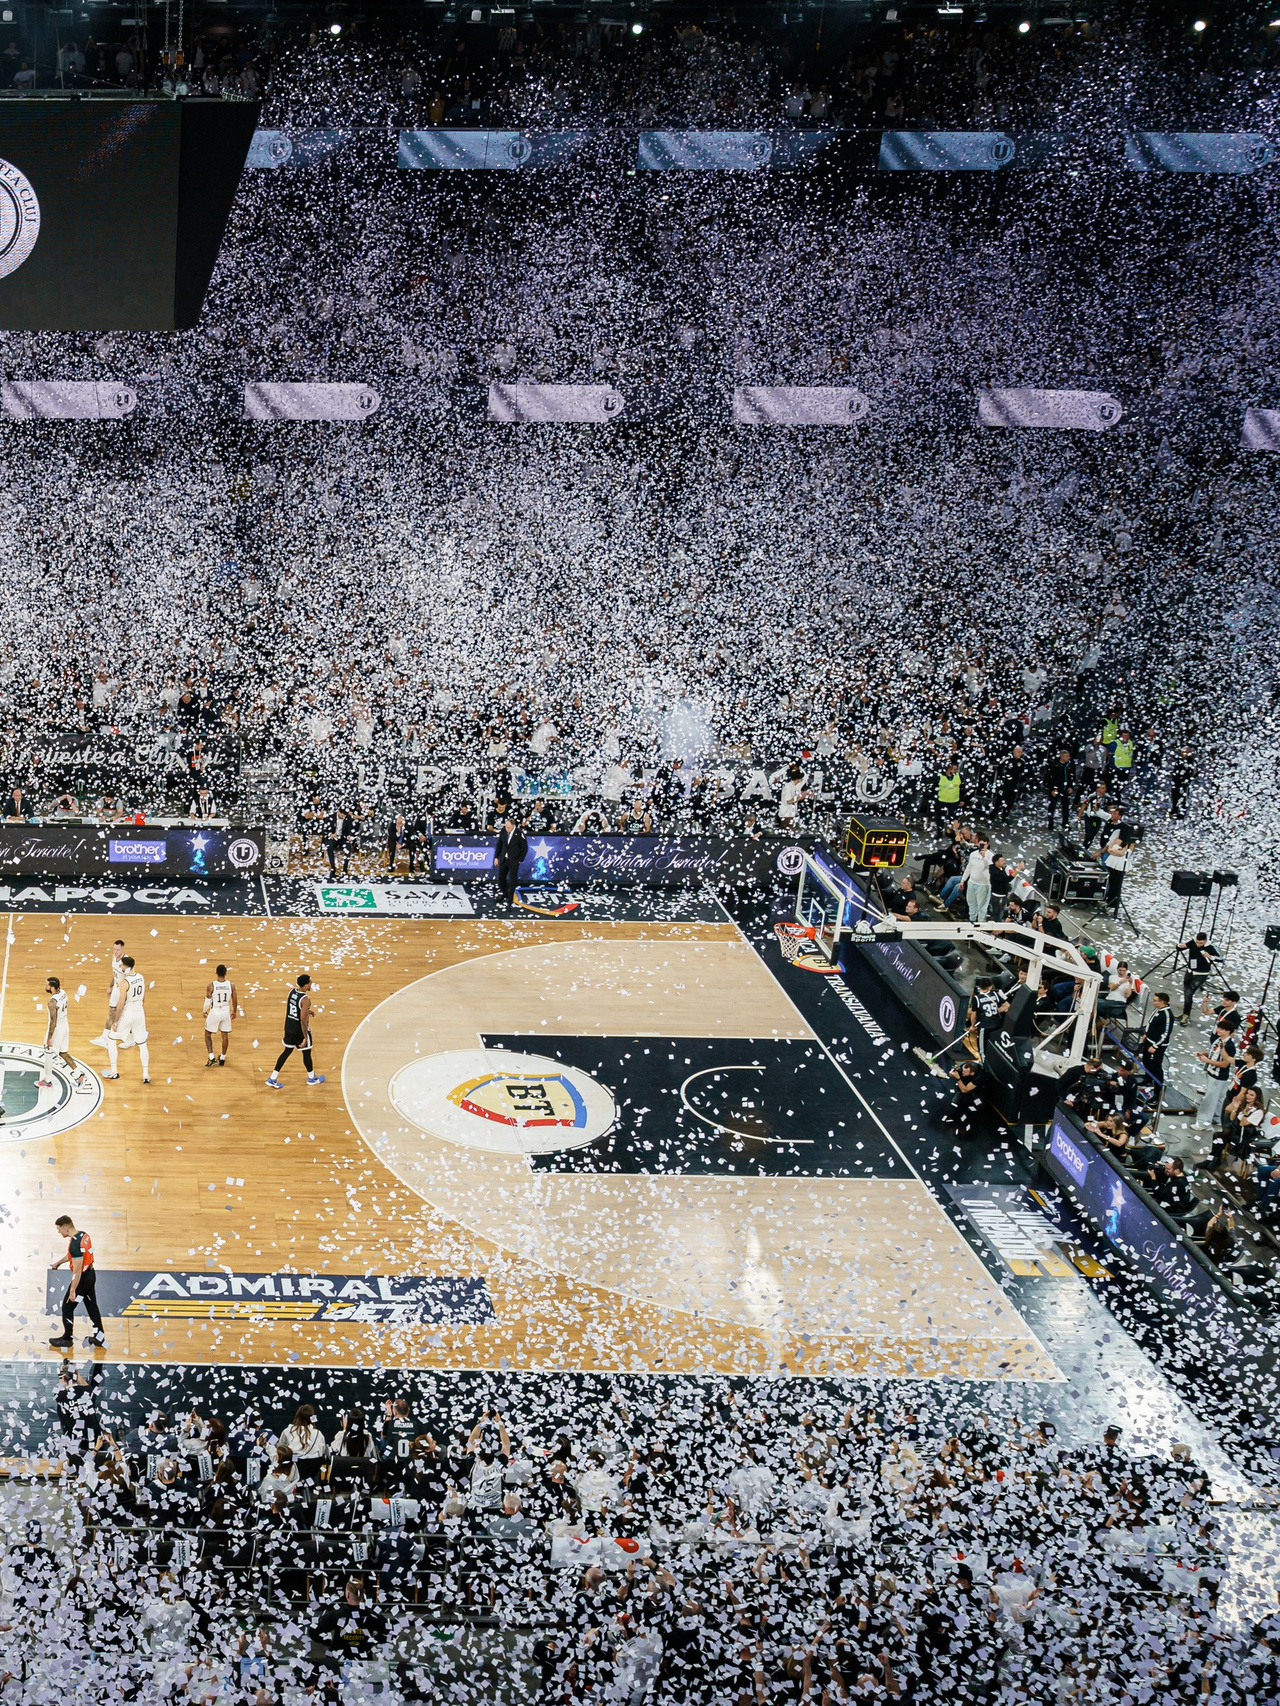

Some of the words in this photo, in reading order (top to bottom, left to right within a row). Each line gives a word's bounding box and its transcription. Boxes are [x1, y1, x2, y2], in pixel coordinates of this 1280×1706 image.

[20, 188, 37, 223] CLUJ
[115, 842, 160, 856] brother
[442, 849, 488, 863] brother
[132, 985, 143, 997] 10
[217, 993, 228, 1003] 11
[824, 974, 885, 1038] TRANSILVANIA
[982, 1004, 998, 1017] 35
[505, 1084, 556, 1116] BT
[1056, 1132, 1085, 1173] brother
[139, 1273, 419, 1301] ADMIRAL
[398, 1438, 410, 1458] 0
